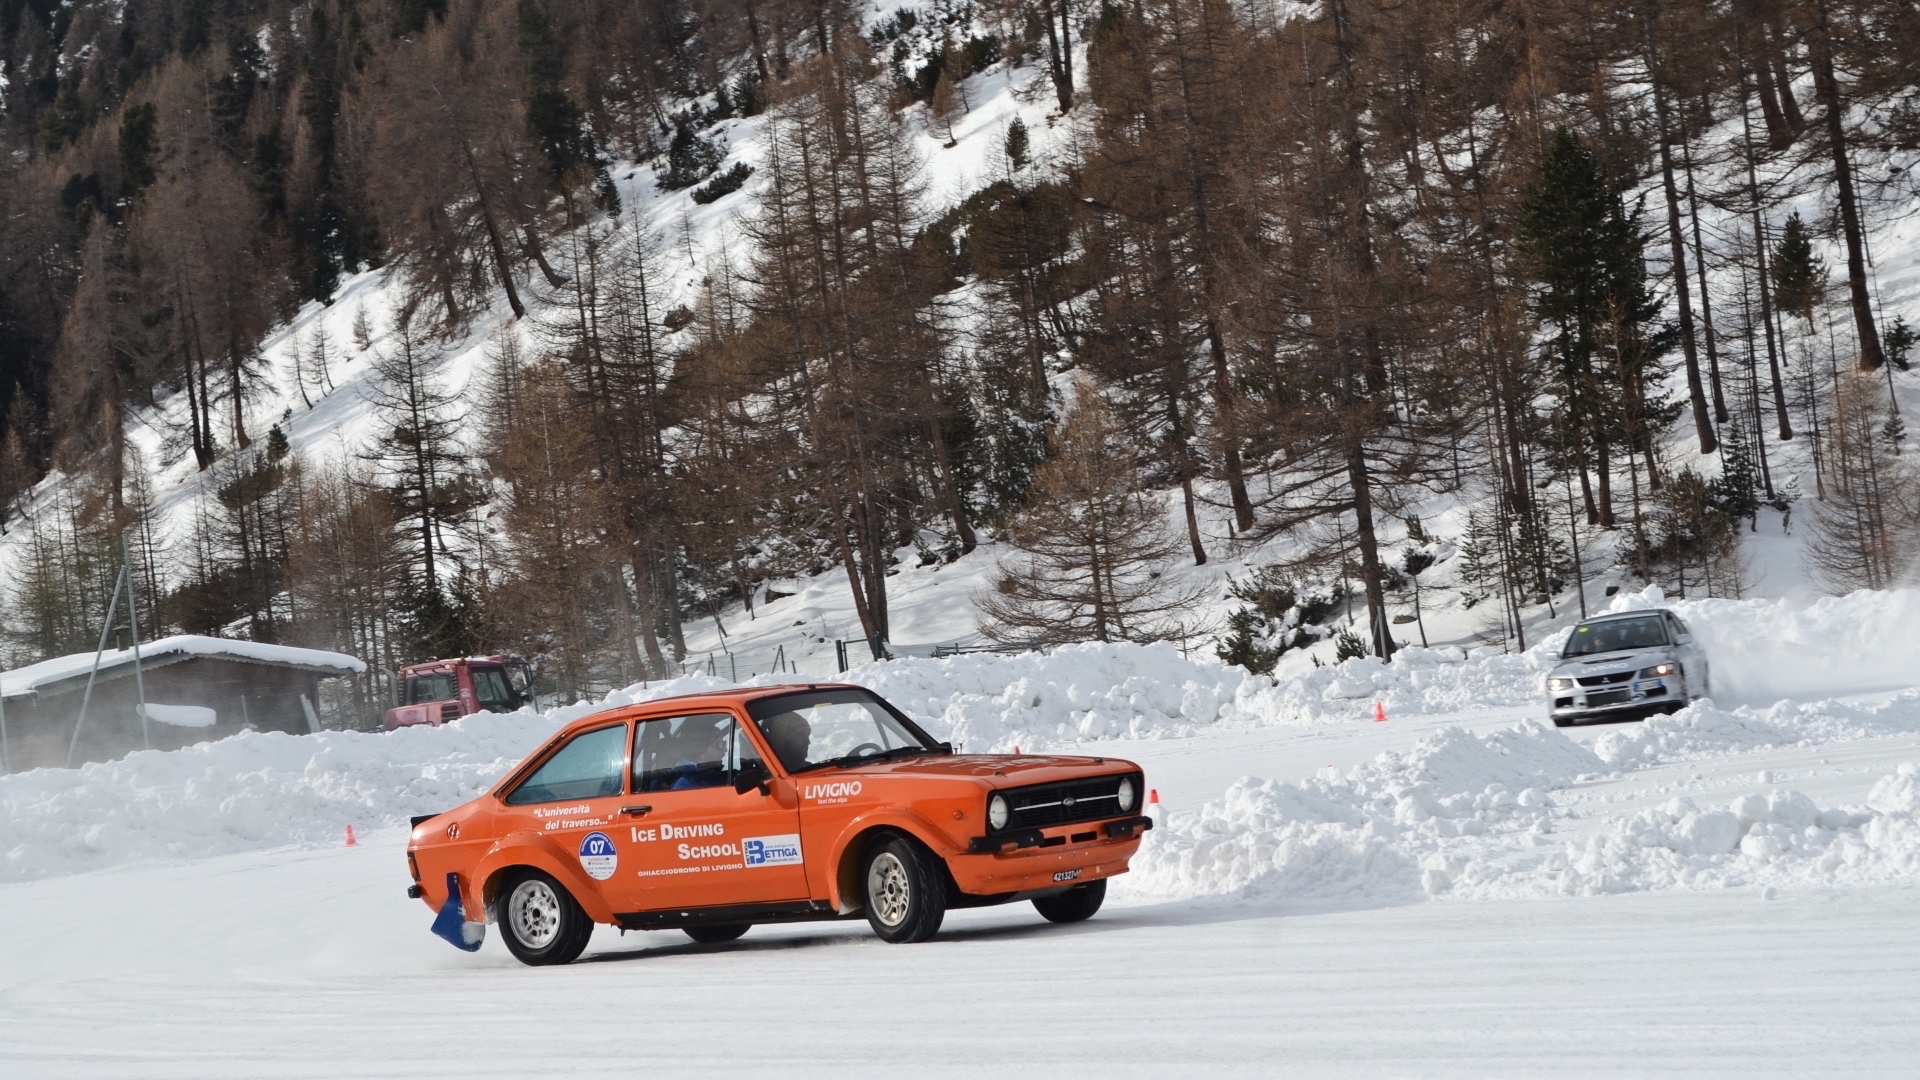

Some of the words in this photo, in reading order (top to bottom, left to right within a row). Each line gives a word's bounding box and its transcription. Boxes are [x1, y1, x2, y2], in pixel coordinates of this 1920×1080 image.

[805, 781, 862, 799] LIVIGNO
[545, 820, 560, 830] del
[631, 826, 657, 843] ICE
[660, 823, 724, 840] DRIVING
[590, 840, 605, 854] 07
[677, 843, 742, 860] SCHOOL
[637, 866, 701, 877] GHIACCIODROMO
[711, 863, 743, 871] LIVIGNO
